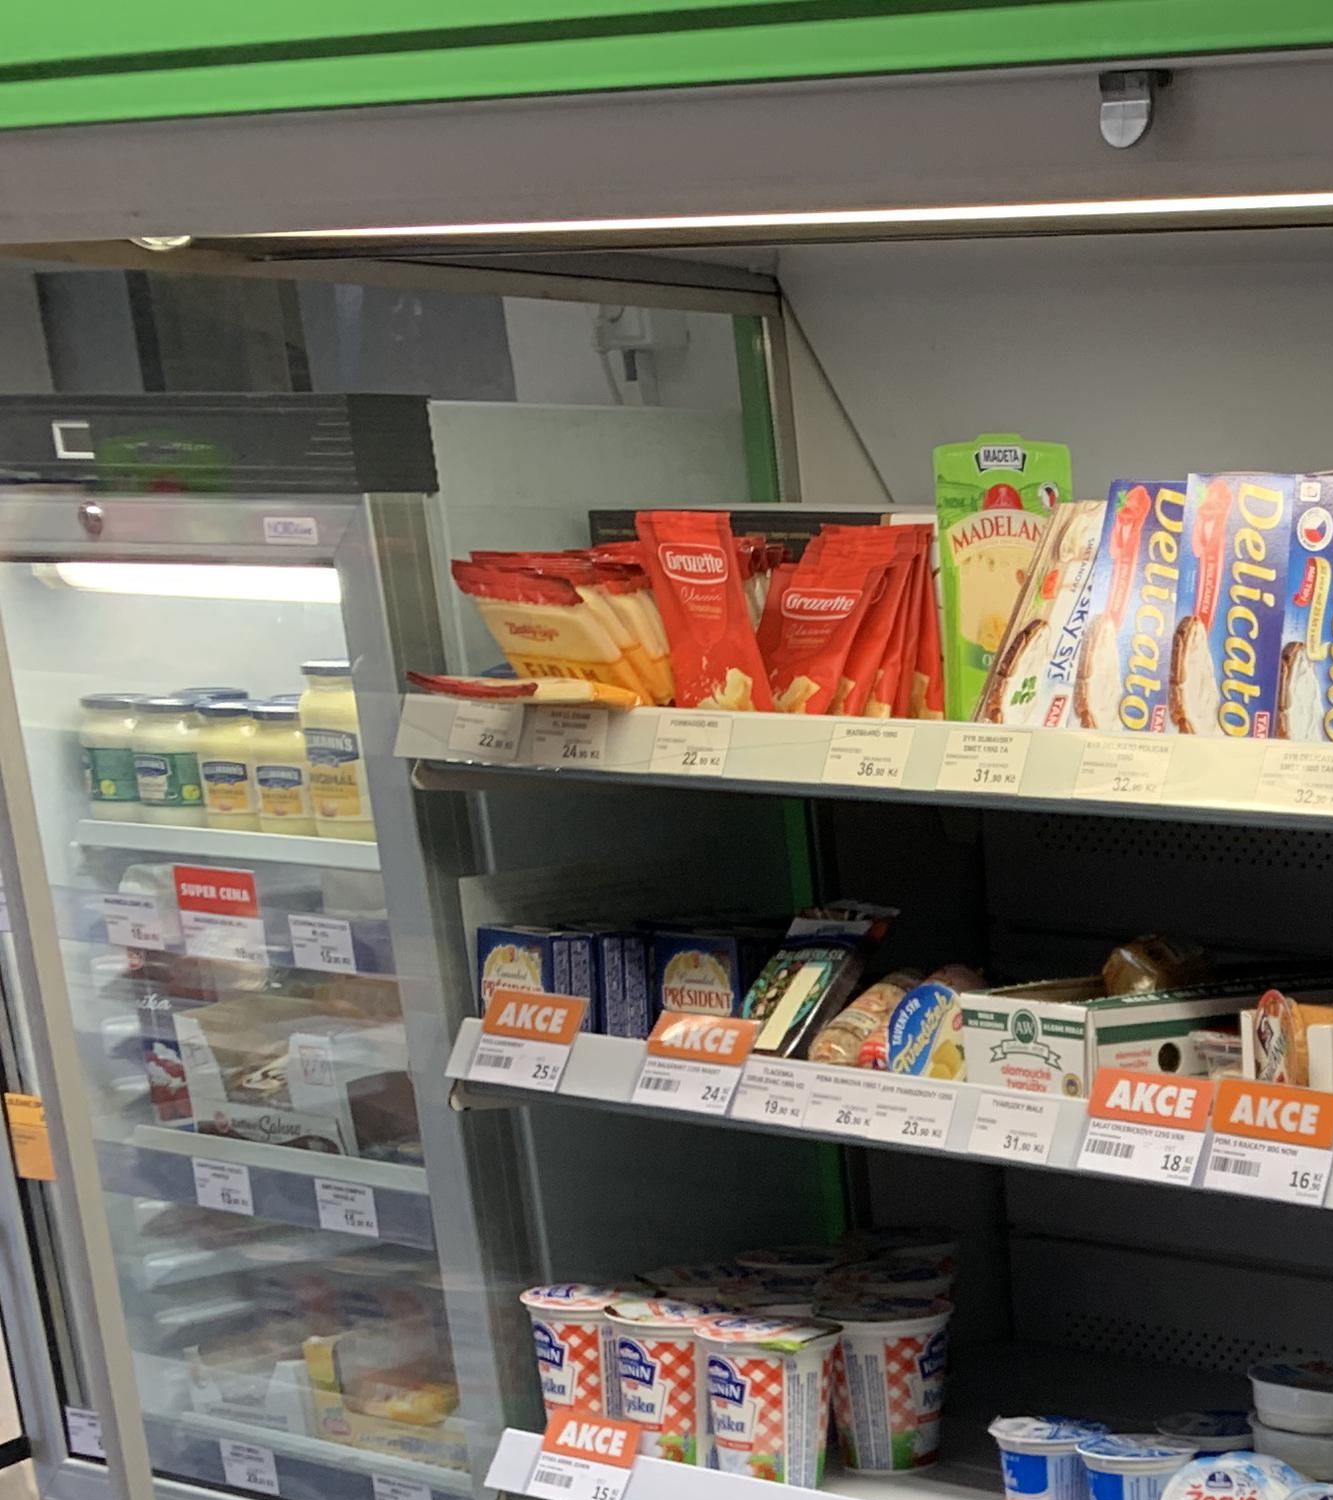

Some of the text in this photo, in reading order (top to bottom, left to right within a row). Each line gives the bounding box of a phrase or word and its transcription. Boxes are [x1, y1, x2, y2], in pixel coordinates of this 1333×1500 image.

[982, 449, 1019, 464] MADETA
[662, 551, 725, 574] Grozette
[785, 593, 855, 615] Grozette
[1219, 483, 1284, 739] Delicato
[664, 986, 732, 1010] PRÉSIDENT
[496, 1002, 567, 1034] AKCE
[1105, 1080, 1197, 1119] AKCE
[1230, 1095, 1321, 1135] AKCE
[556, 1421, 628, 1457] AKCE
